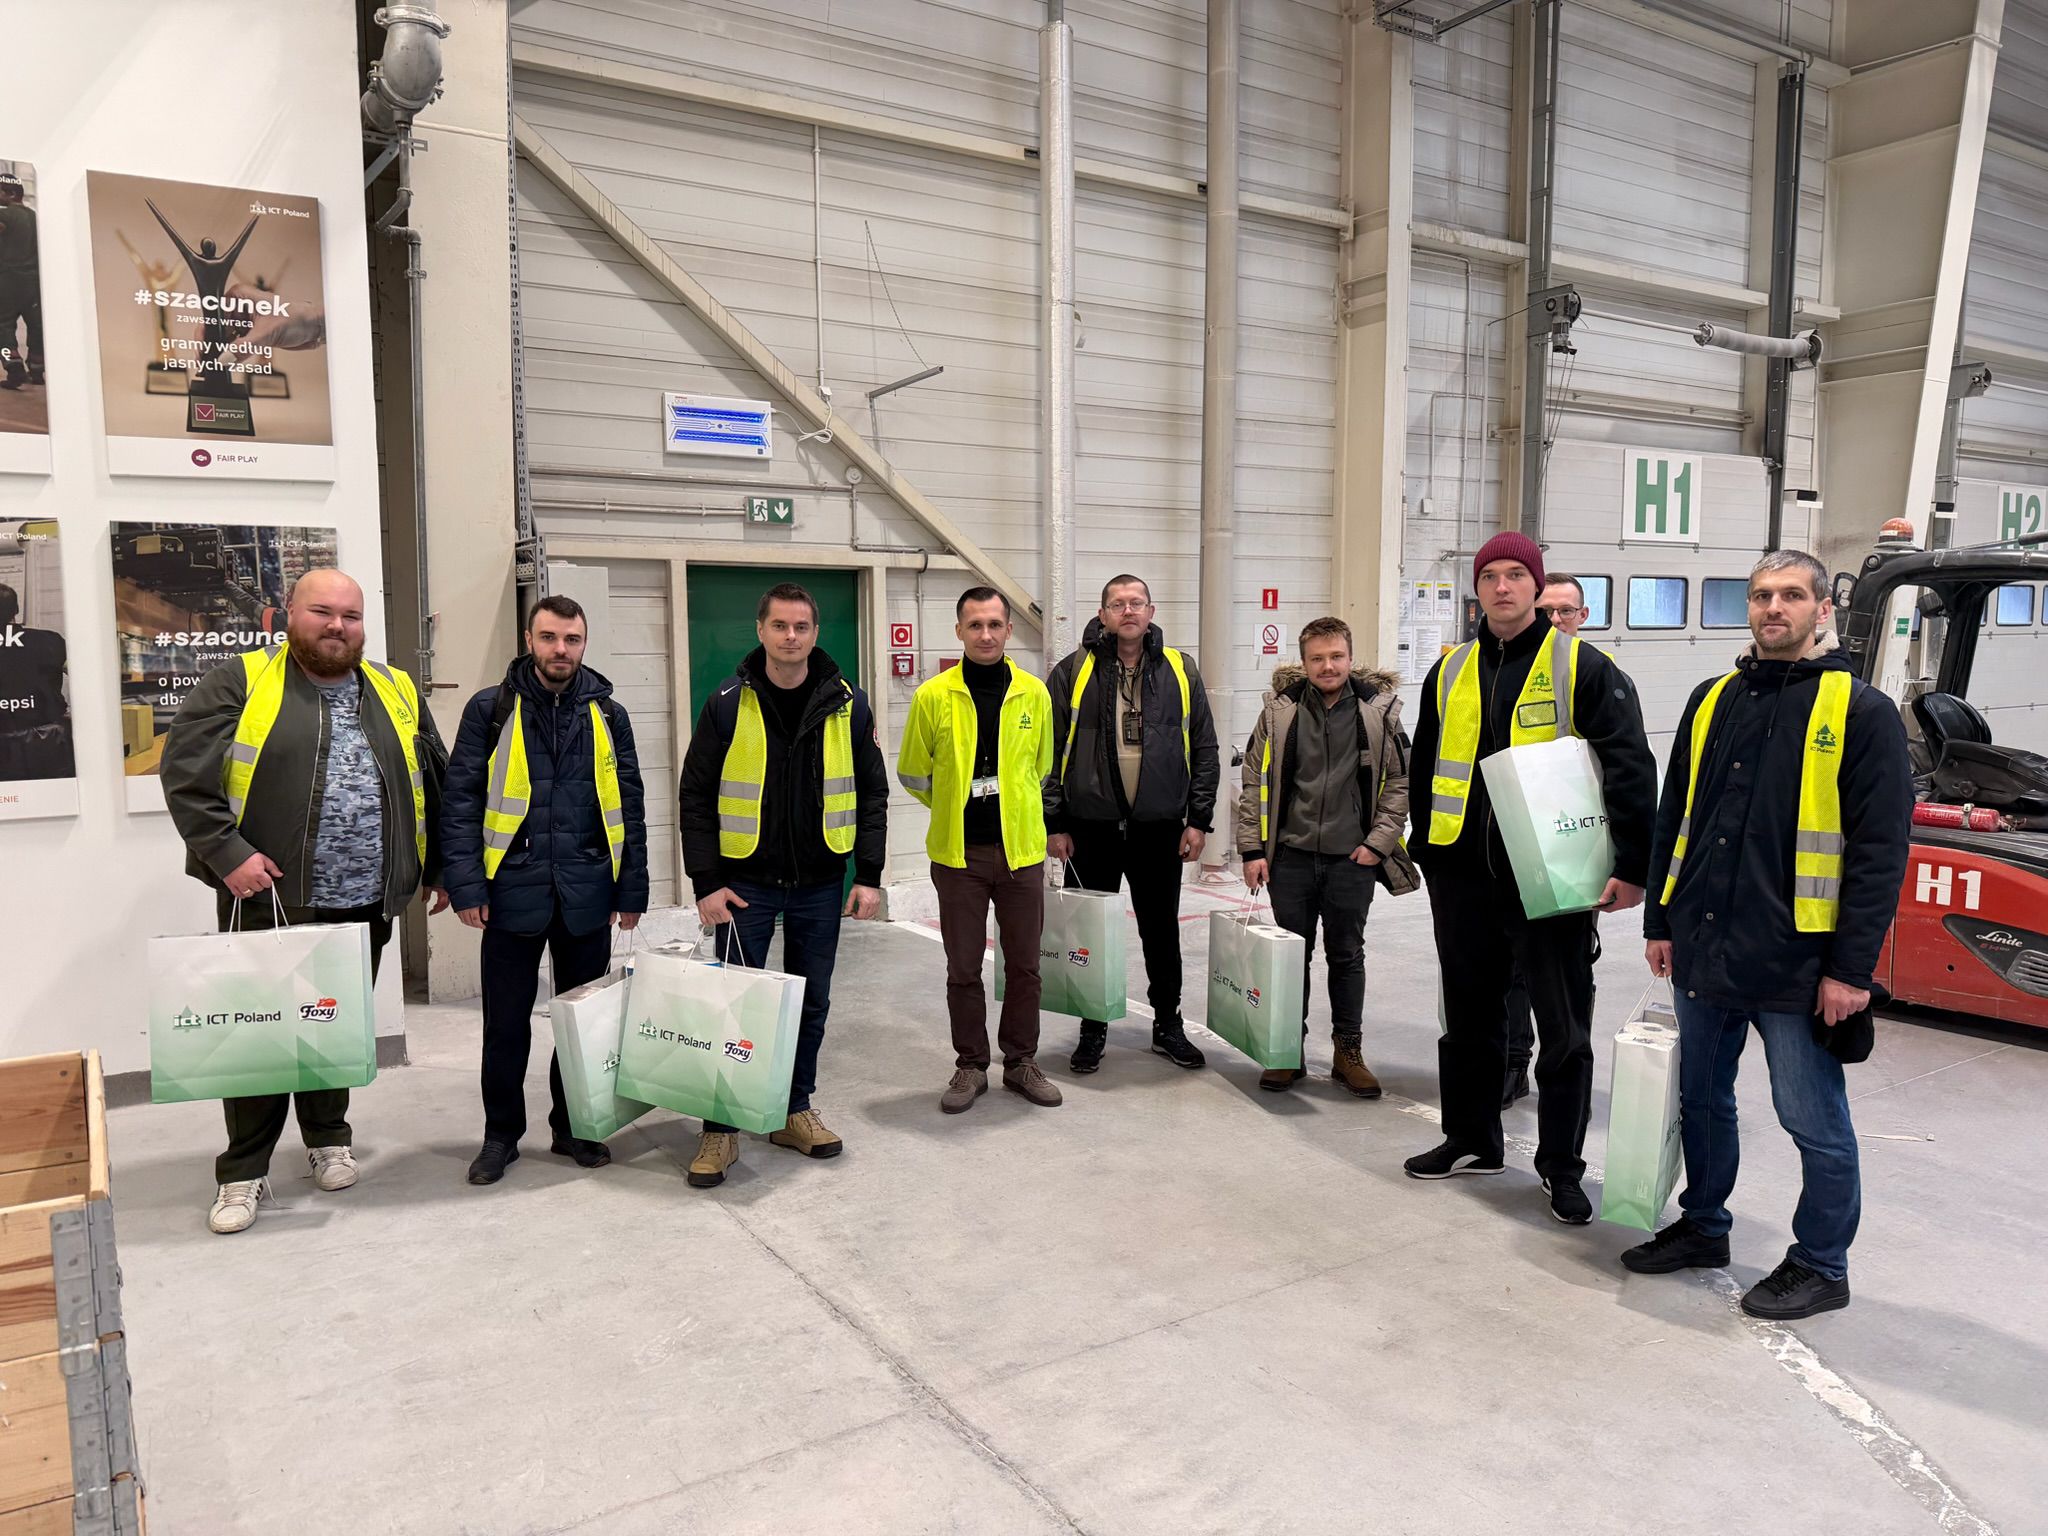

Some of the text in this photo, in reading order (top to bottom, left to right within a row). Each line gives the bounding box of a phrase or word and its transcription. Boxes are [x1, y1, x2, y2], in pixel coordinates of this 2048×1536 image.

[268, 206, 281, 214] ICT
[283, 208, 310, 218] Poland
[134, 289, 291, 317] #szacunek
[176, 314, 254, 328] zawsze wraca
[160, 337, 272, 358] gramy według
[163, 355, 272, 375] jasnych zasad
[237, 455, 259, 463] PLAY
[1634, 458, 1691, 535] H1
[2001, 492, 2041, 550] H2
[17, 532, 47, 541] Poland
[154, 630, 289, 647] #szacune
[158, 676, 201, 689] o pow
[0, 695, 35, 712] epsi
[160, 693, 186, 705] dba
[0, 795, 20, 803] ENIE
[1579, 816, 1595, 828] ICT
[1915, 862, 1983, 911] H1
[1975, 930, 2023, 948] Linde
[1040, 949, 1059, 959] oland
[1068, 951, 1088, 965] Foxy
[207, 1013, 229, 1025] ICT
[234, 1011, 281, 1024] Poland
[300, 1004, 335, 1019] Foxy
[660, 1029, 675, 1041] ICT
[677, 1034, 712, 1051] Poland
[724, 1041, 751, 1061] Foxy
